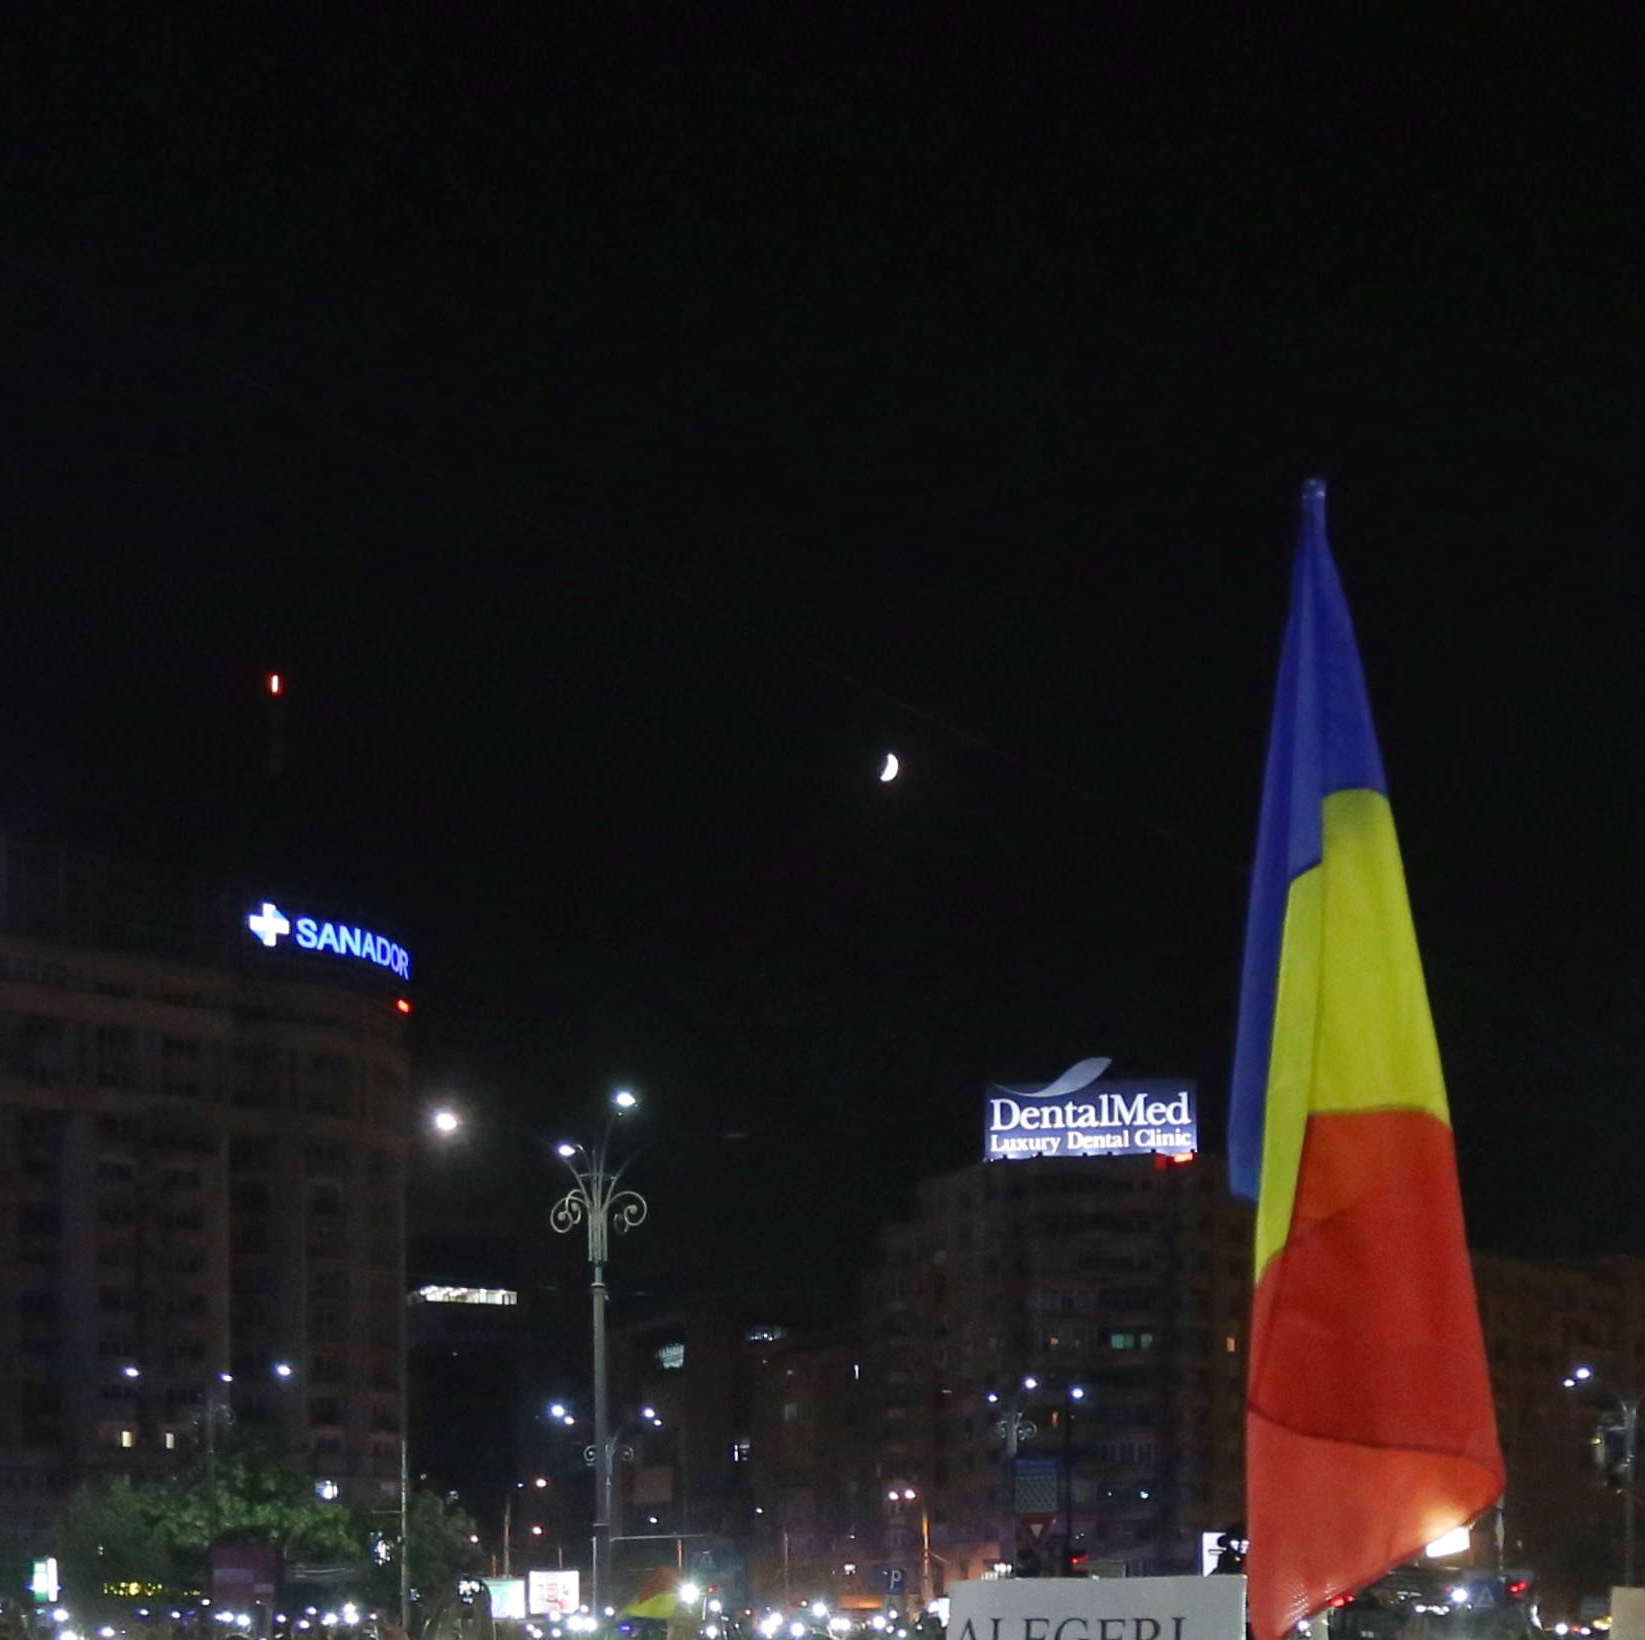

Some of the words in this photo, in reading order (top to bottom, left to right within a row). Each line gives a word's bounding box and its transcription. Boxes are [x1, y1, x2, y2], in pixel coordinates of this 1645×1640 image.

[296, 917, 410, 980] SANADOR
[989, 1091, 1192, 1131] DentalMed
[990, 1134, 1061, 1153] Luxury
[1067, 1129, 1130, 1149] Dental
[1134, 1128, 1192, 1148] Clinic
